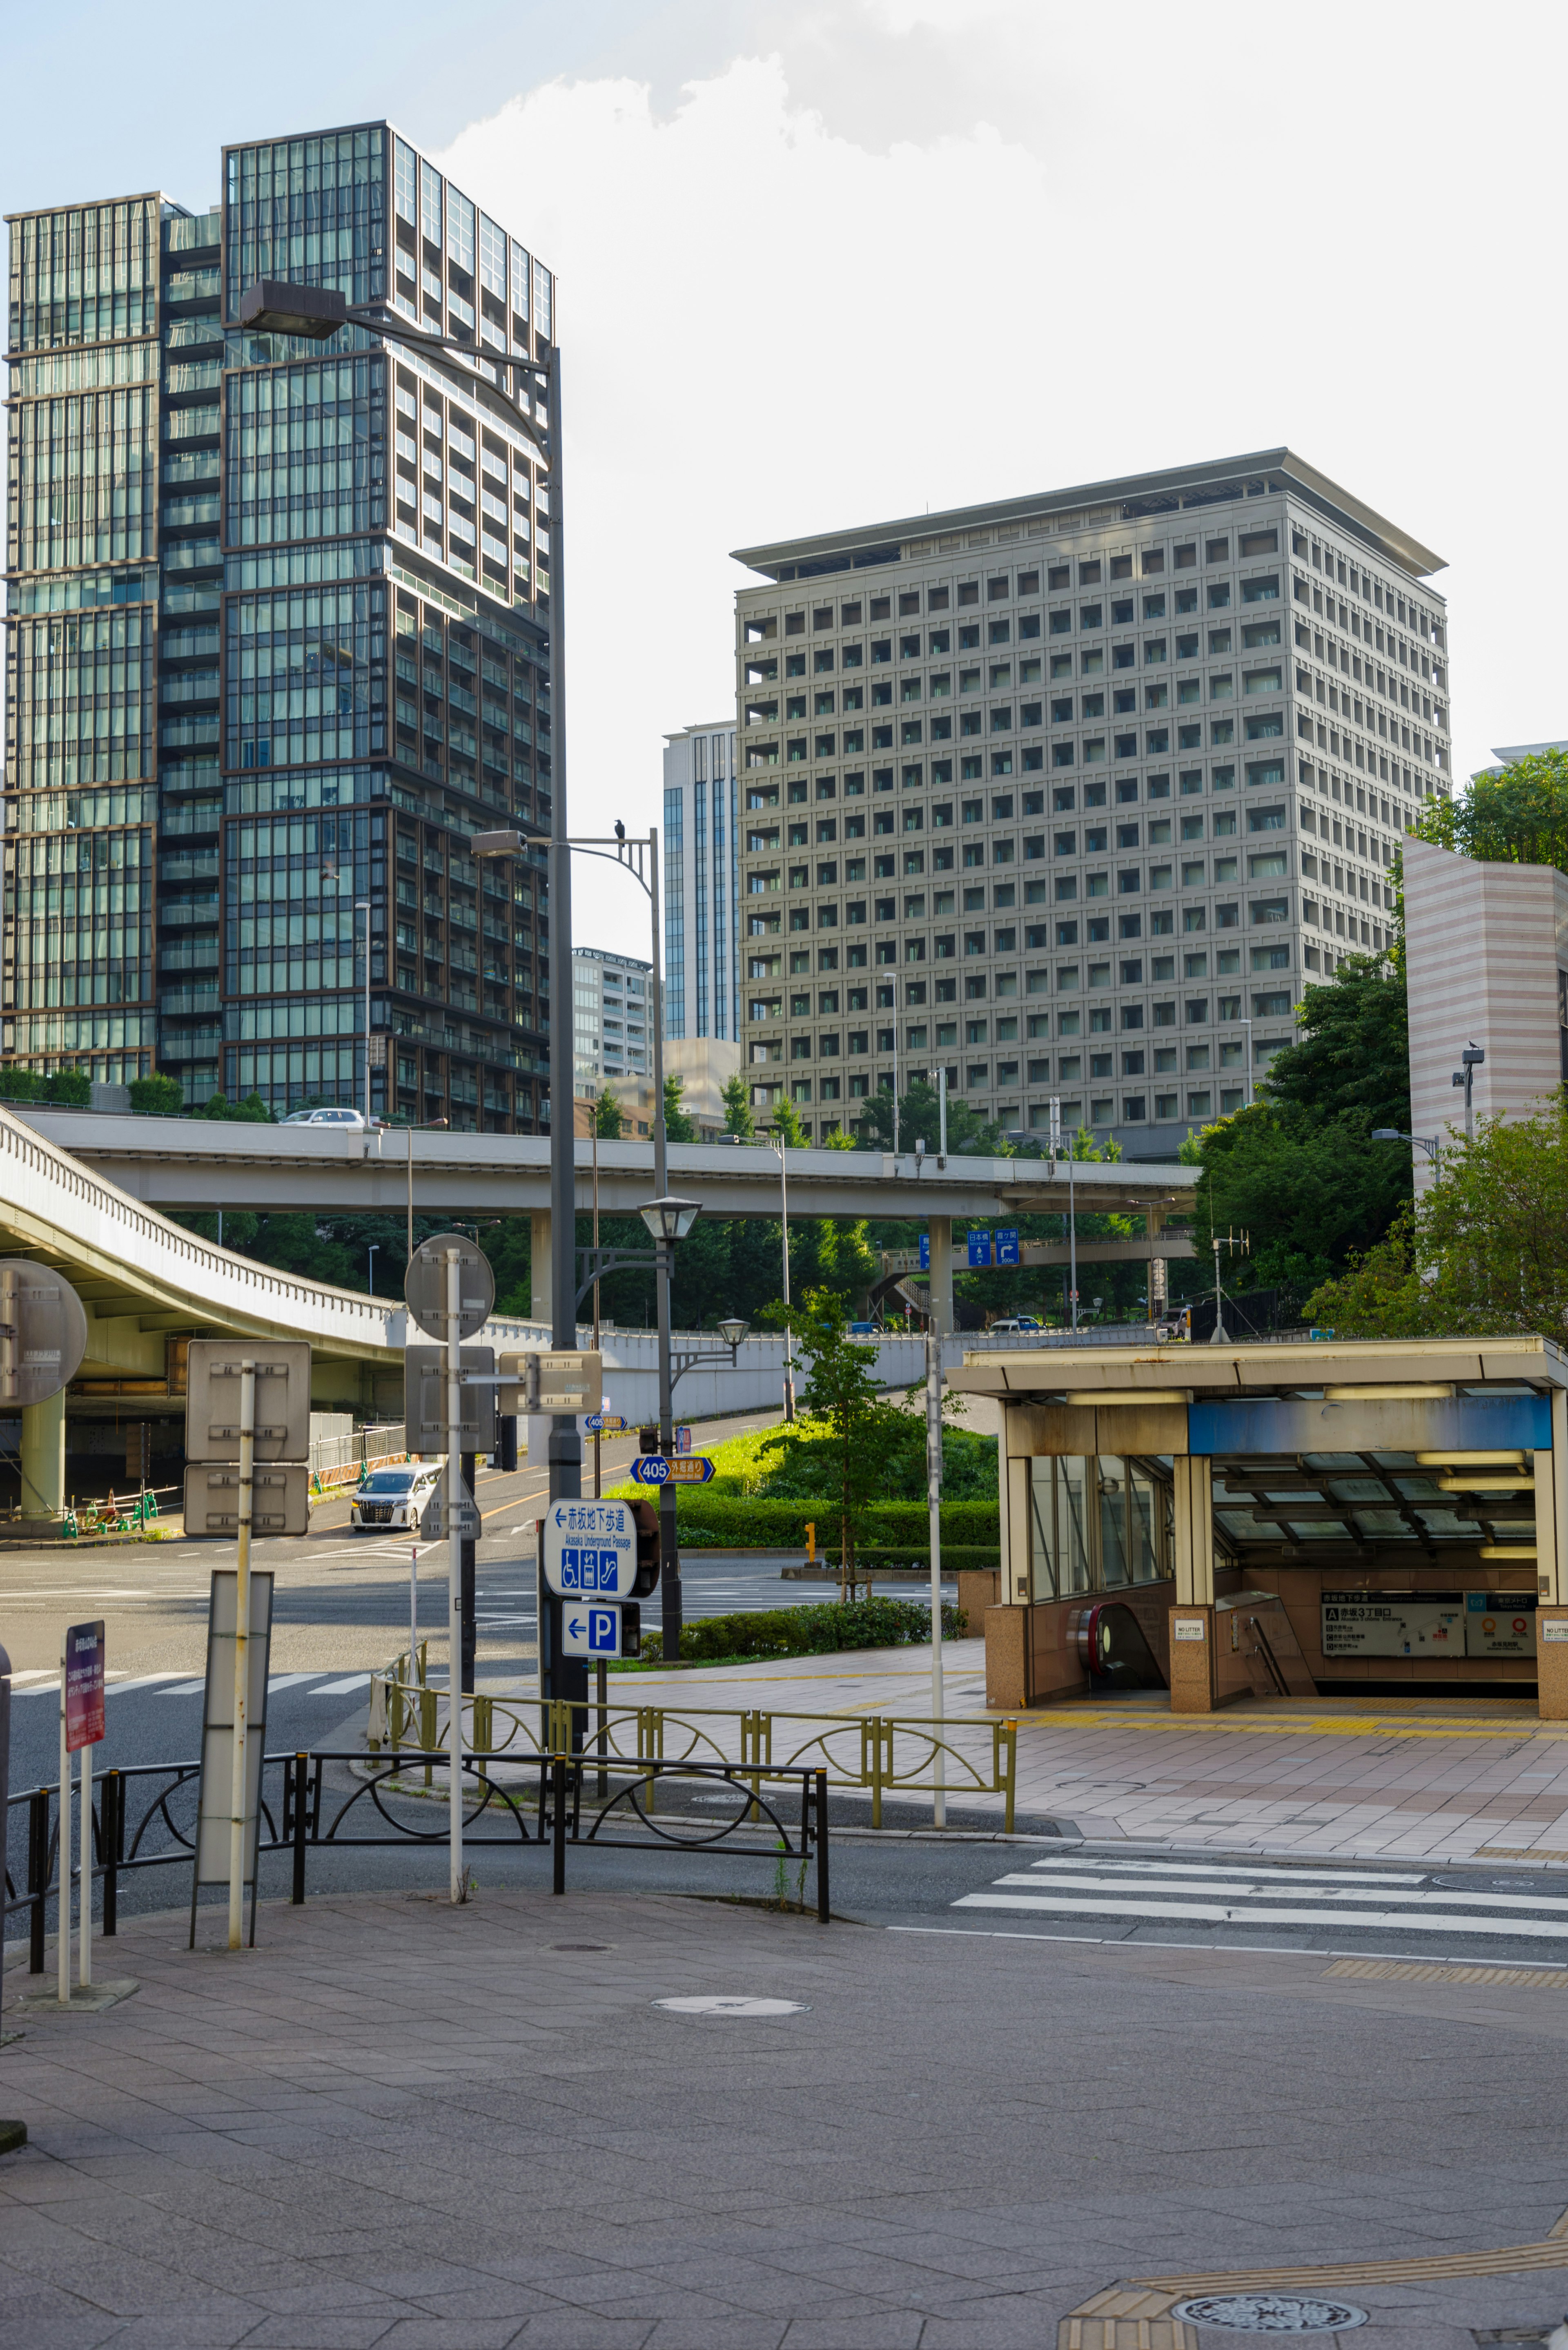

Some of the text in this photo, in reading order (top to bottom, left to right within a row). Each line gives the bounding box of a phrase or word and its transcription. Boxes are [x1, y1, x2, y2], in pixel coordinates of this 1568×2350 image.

[643, 1463, 666, 1478] 405
[672, 1461, 702, 1473] 外堀通り
[568, 1507, 624, 1532] 赤坂地下歩道
[566, 1534, 631, 1551] Akasaka Underground Passage
[1328, 1608, 1391, 1620] A 赤坂3丁目口
[596, 1614, 611, 1646] P
